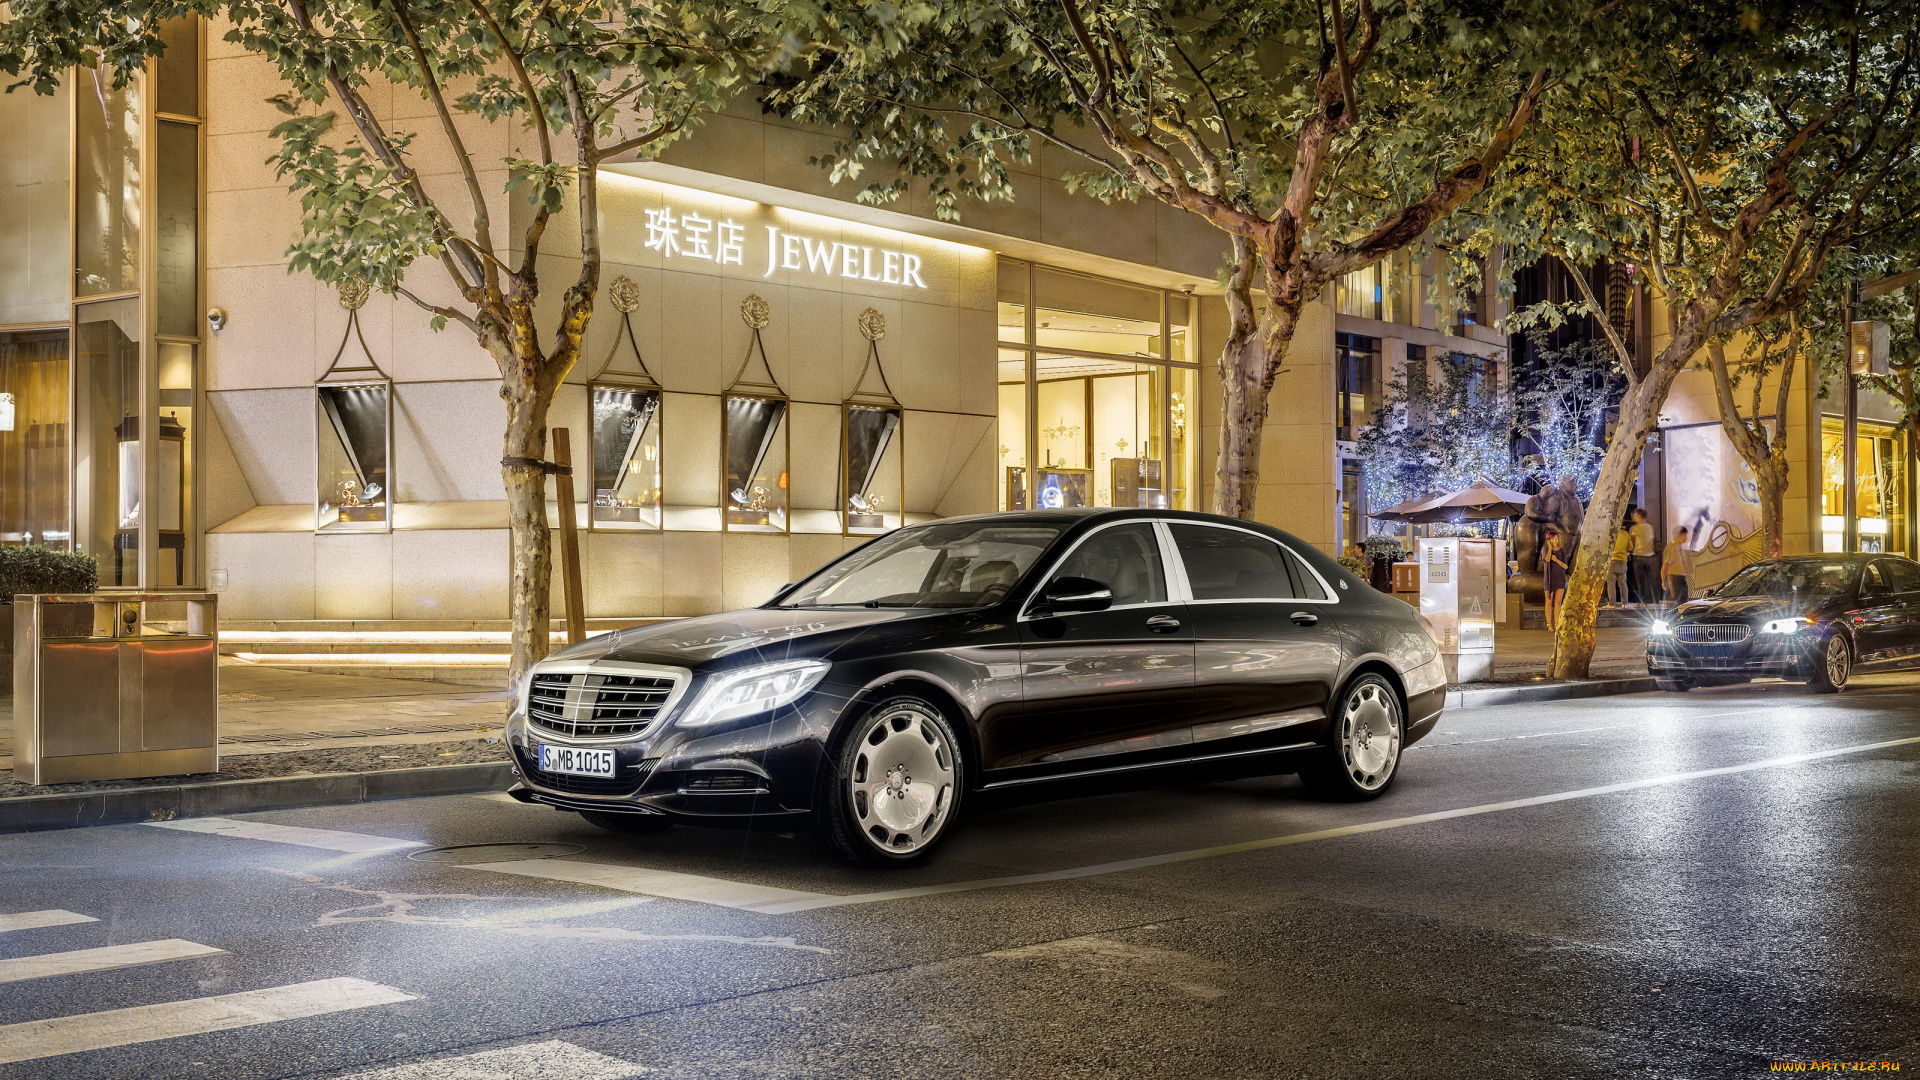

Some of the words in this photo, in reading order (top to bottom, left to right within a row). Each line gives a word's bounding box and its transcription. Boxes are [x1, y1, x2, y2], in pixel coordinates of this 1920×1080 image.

[643, 207, 745, 266] 珠宝店
[763, 226, 928, 288] JEWELER
[545, 748, 551, 768] S
